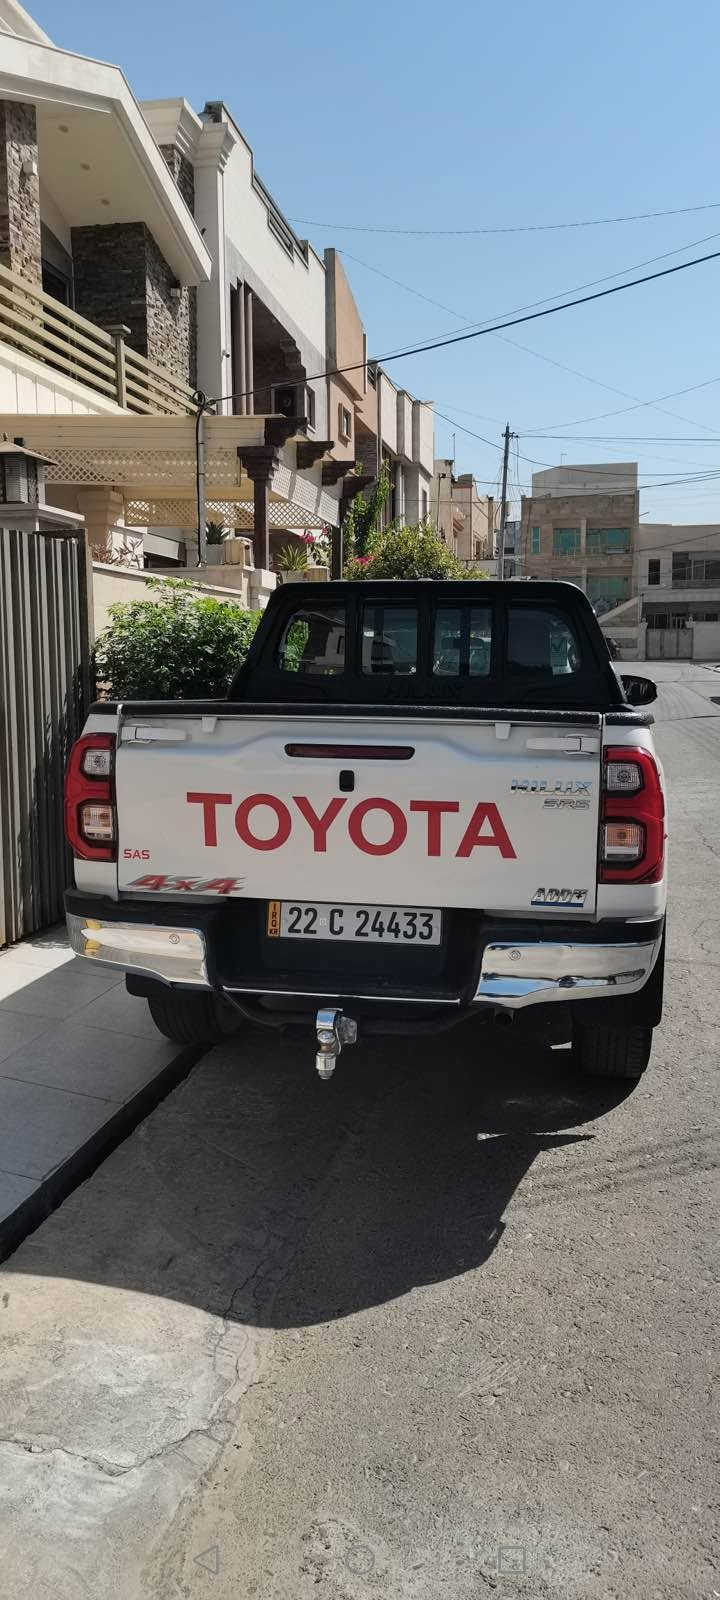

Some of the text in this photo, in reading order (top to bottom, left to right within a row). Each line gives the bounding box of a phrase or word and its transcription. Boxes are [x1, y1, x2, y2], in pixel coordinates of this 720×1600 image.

[511, 779, 592, 795] HILUX
[187, 792, 518, 859] TOYOTA
[123, 849, 150, 859] SAS
[287, 906, 434, 940] 22 C 24433
